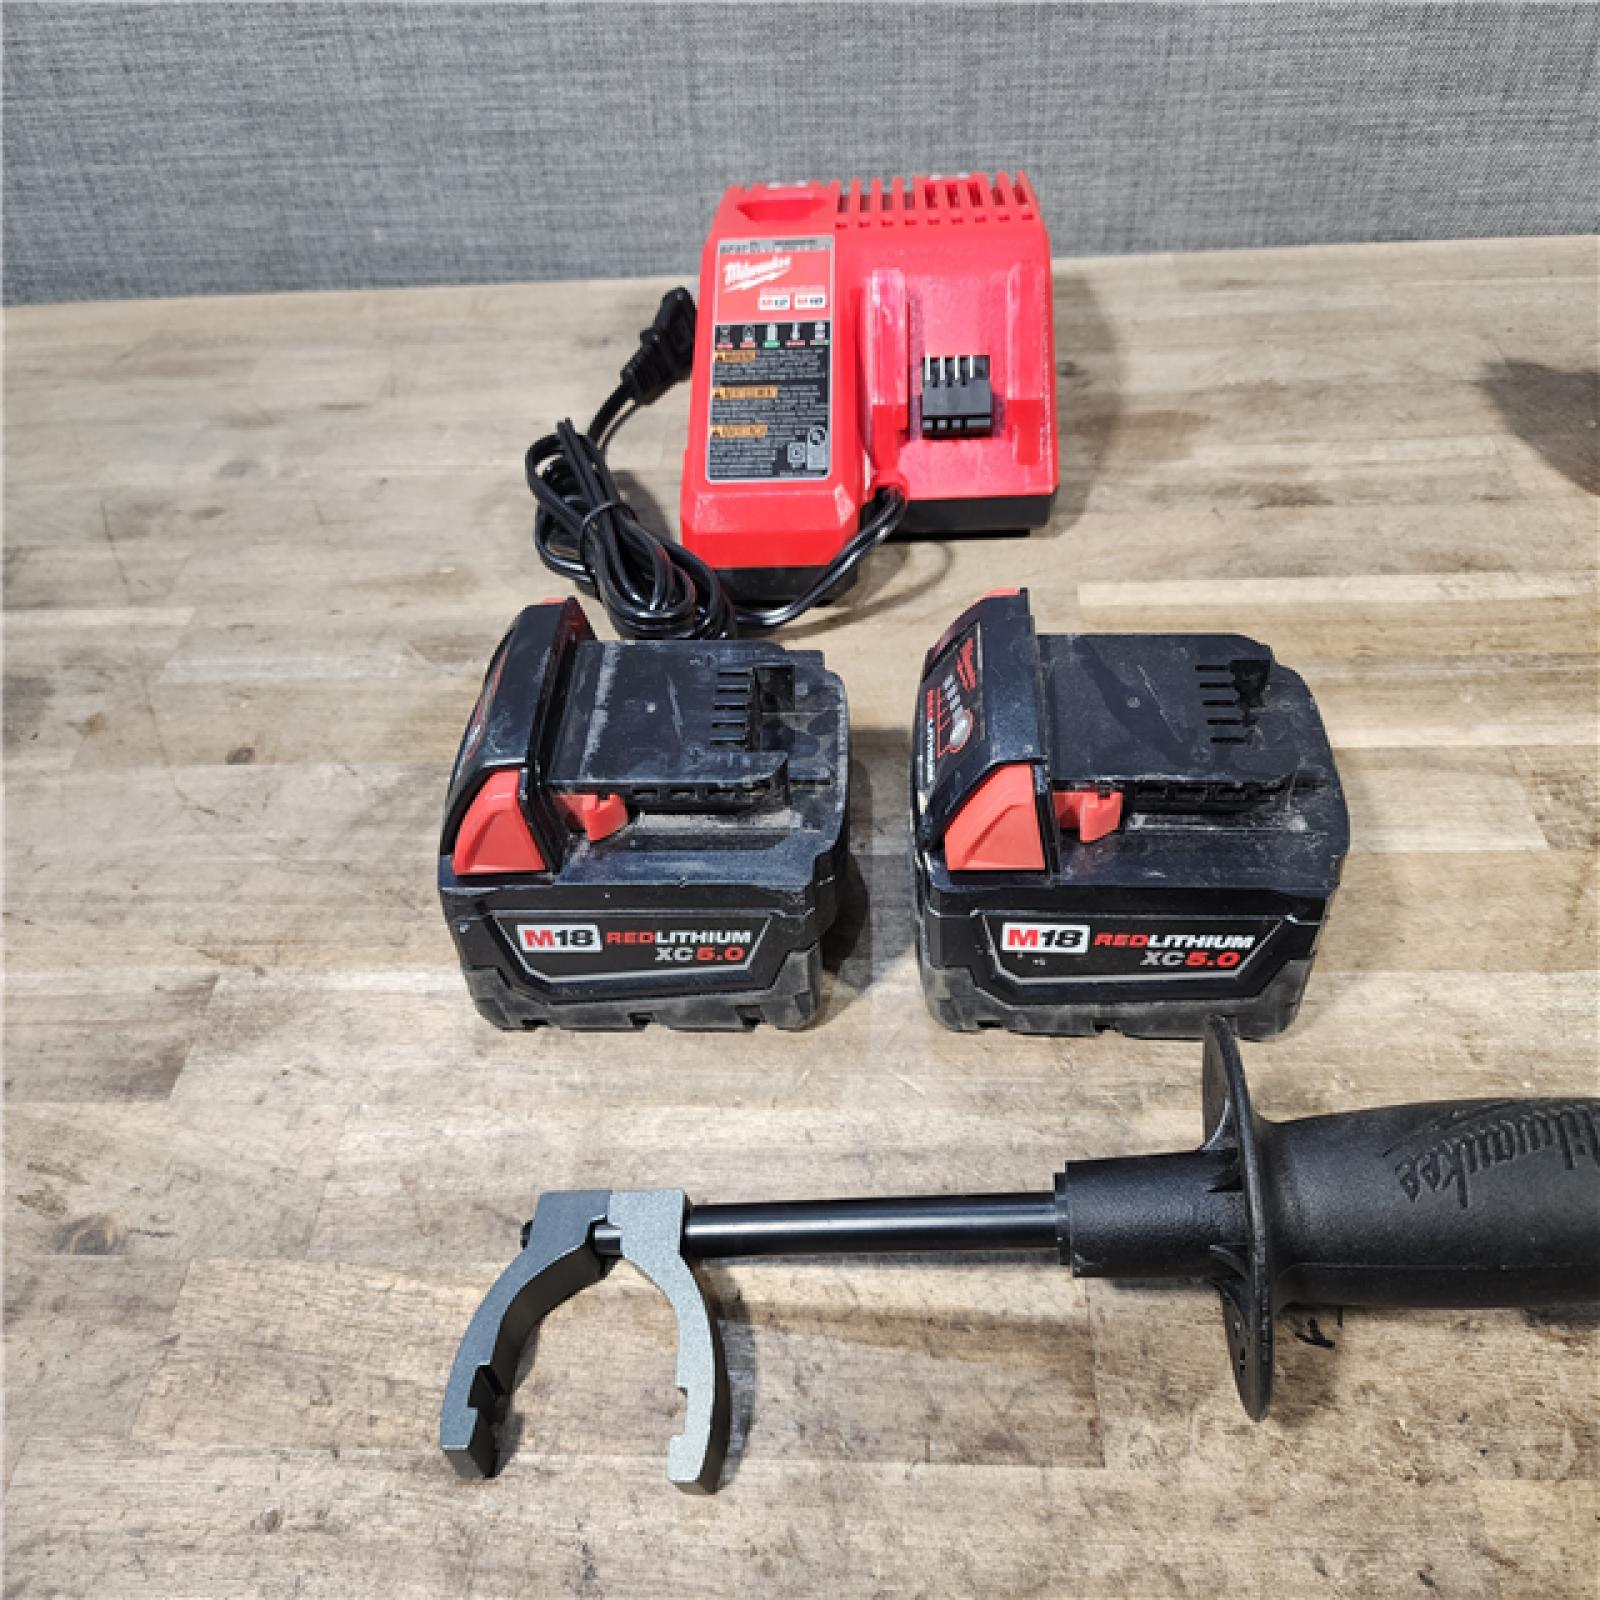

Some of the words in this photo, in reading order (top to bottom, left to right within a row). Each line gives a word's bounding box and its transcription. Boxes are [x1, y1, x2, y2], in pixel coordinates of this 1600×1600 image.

[522, 928, 595, 948] M18
[606, 929, 752, 945] REDLITHIUM
[1006, 928, 1083, 948] M18
[1093, 934, 1256, 949] REDLITHIUM
